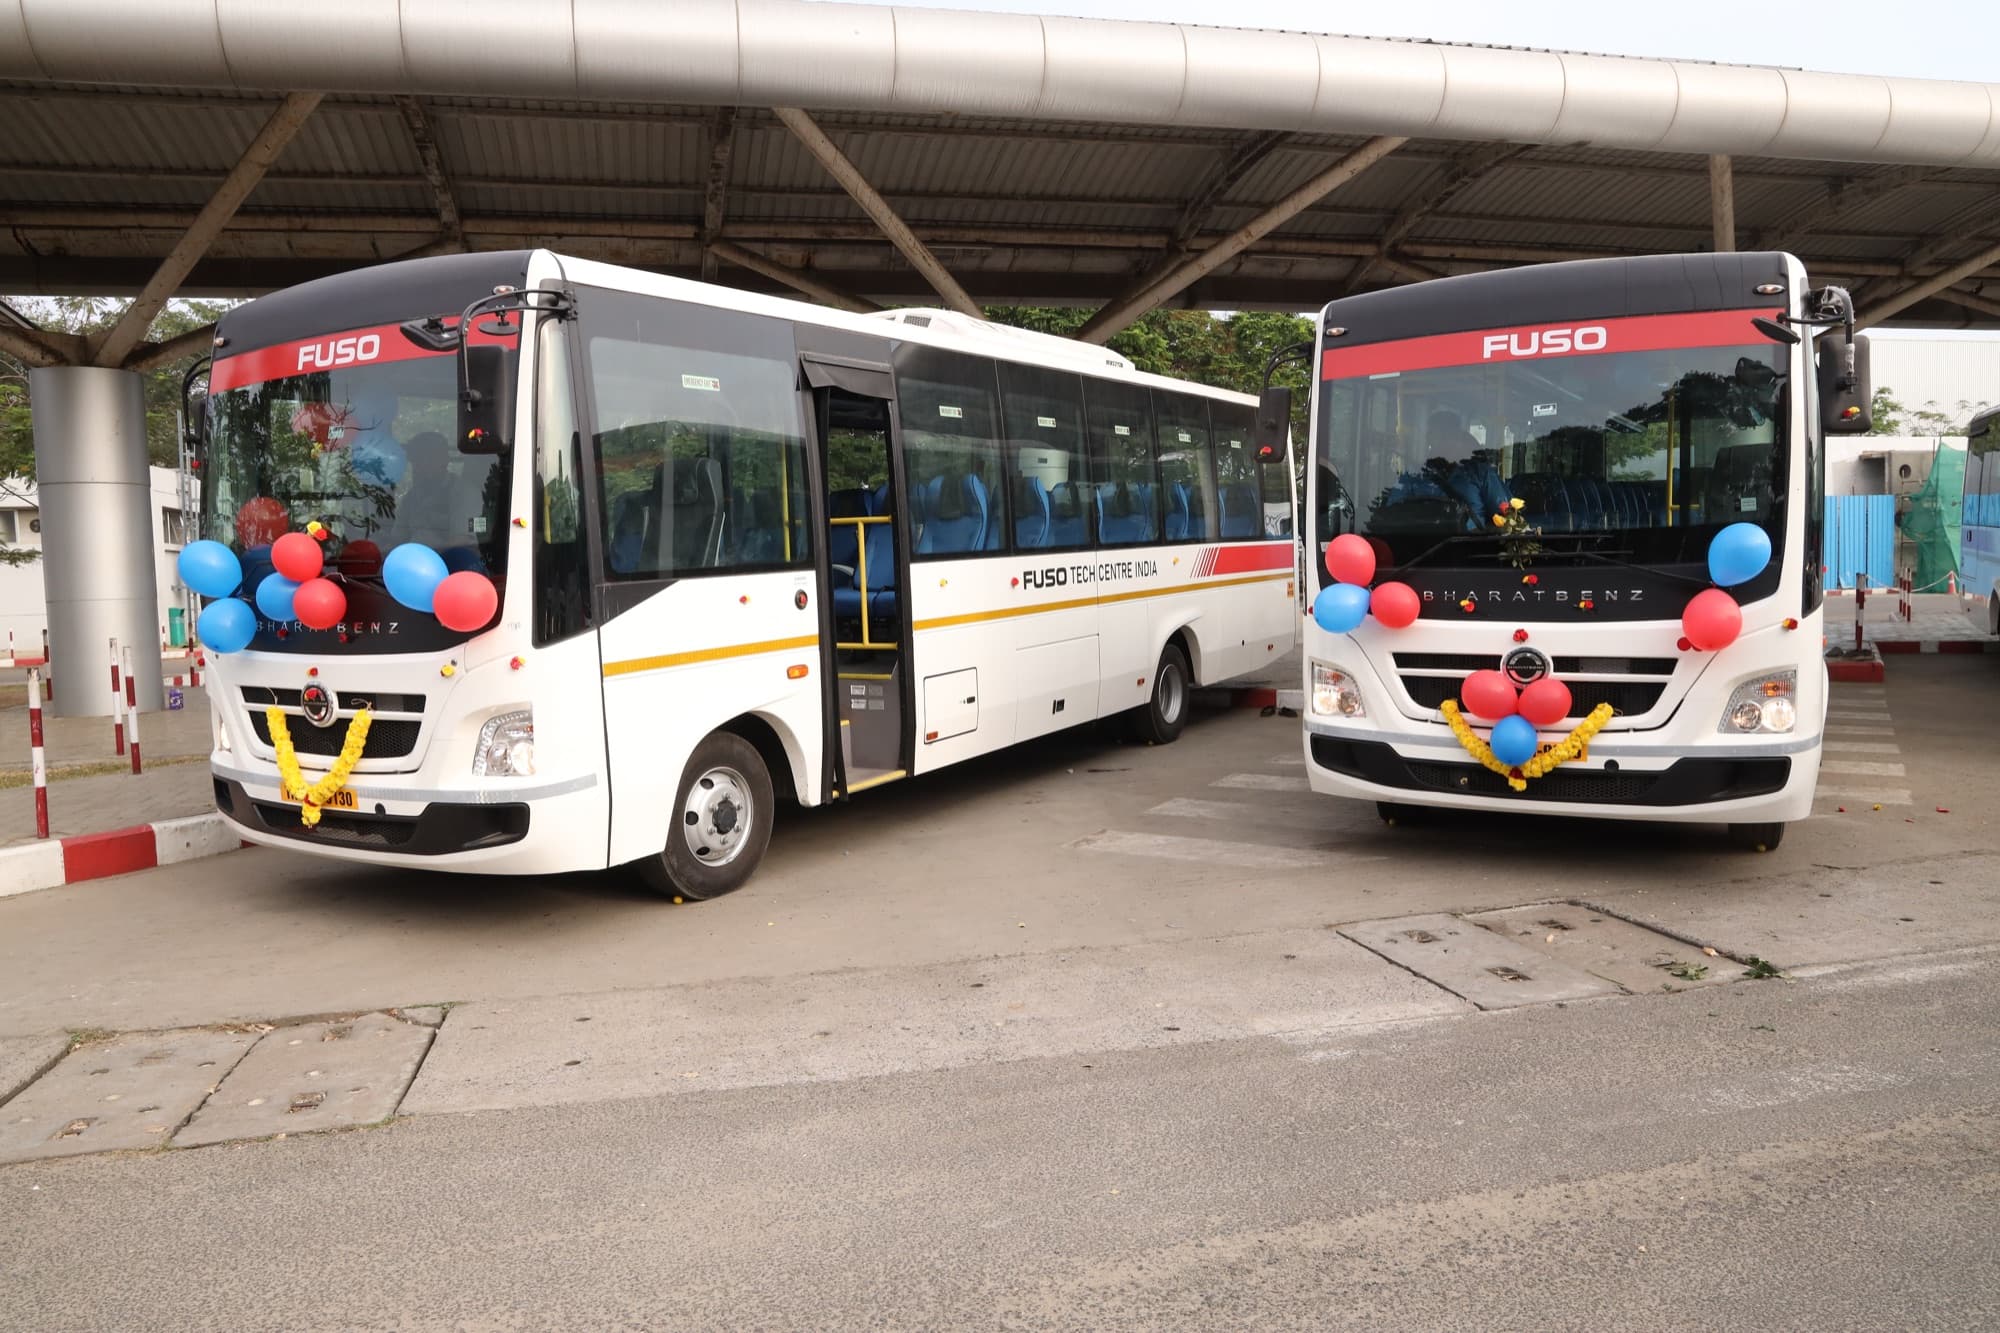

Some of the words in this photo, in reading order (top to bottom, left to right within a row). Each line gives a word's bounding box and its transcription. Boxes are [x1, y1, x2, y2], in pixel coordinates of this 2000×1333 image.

[297, 334, 380, 371] FUSO
[1483, 326, 1607, 359] FUSO
[1023, 567, 1067, 590] FUSO
[1070, 565, 1096, 585] TECH
[1098, 561, 1132, 581] CENTRE
[1135, 560, 1157, 577] INDIA
[1423, 590, 1643, 601] BHARATBENZ
[256, 621, 399, 634] BHARBENZ
